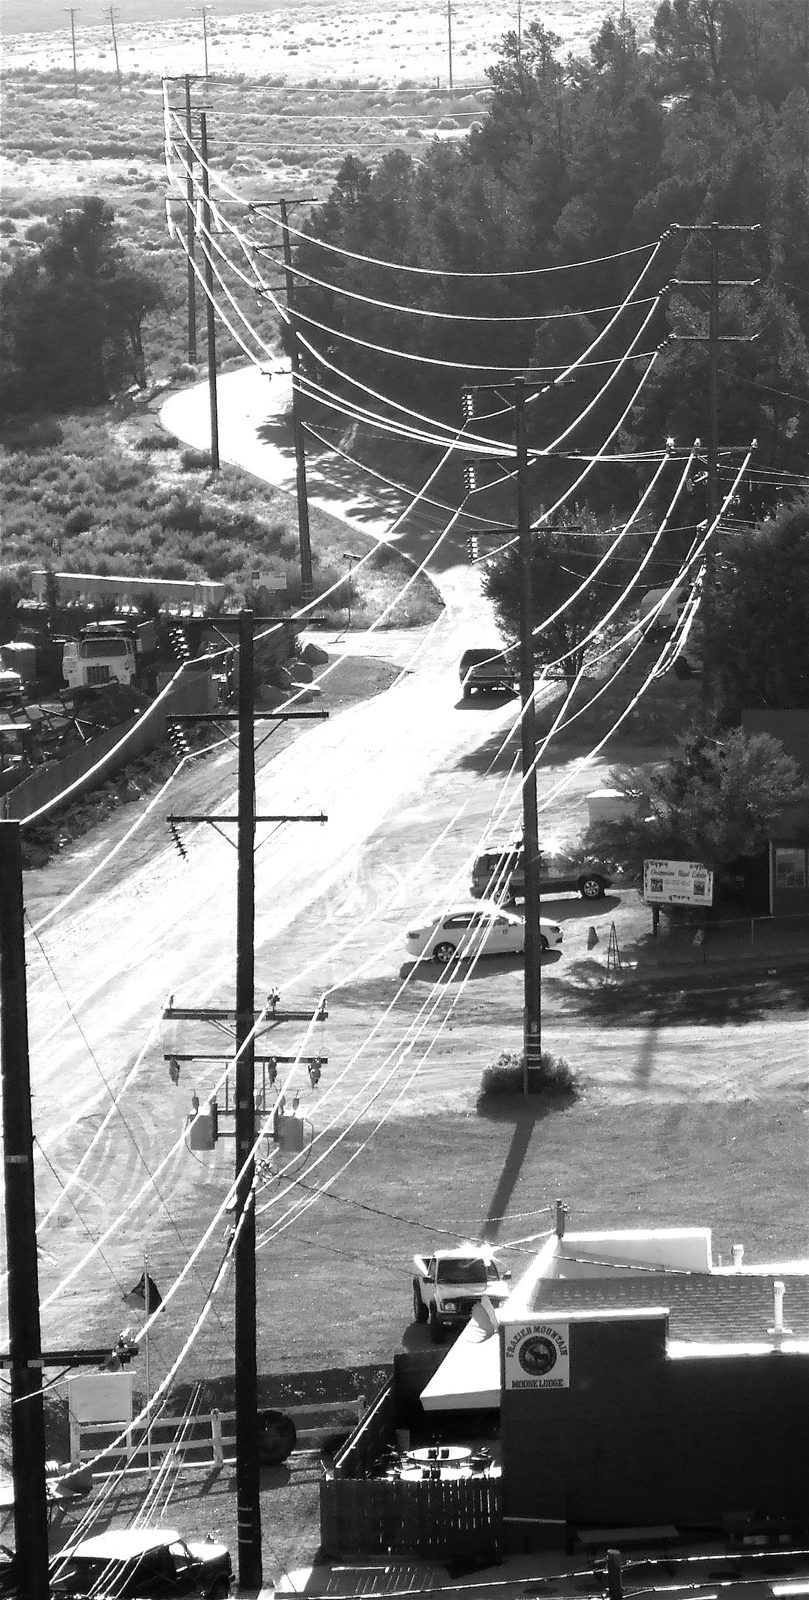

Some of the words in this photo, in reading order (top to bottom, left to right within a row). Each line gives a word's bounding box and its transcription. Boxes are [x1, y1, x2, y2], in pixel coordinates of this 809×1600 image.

[506, 1326, 532, 1358] FRAZIER
[533, 1325, 568, 1356] MOUNTAIN
[512, 1380, 538, 1388] MOOSE
[539, 1379, 563, 1387] LODGE
